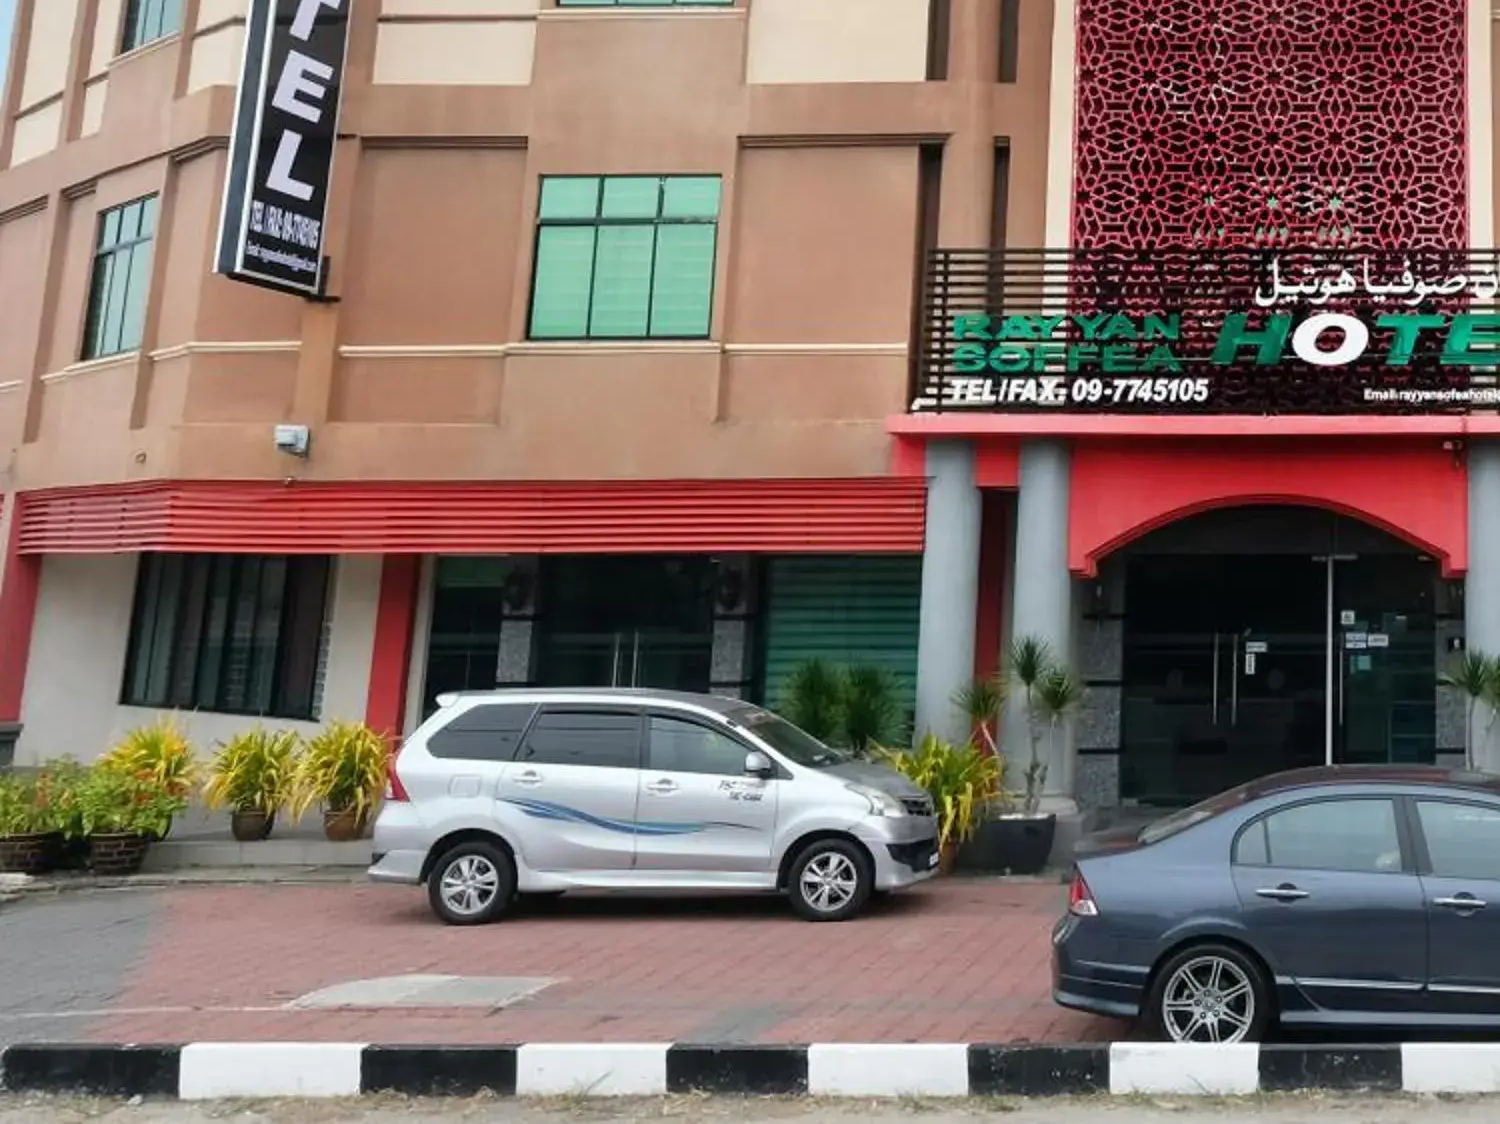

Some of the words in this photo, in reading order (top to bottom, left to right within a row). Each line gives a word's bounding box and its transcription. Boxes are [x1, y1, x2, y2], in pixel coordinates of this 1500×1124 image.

[952, 313, 1181, 341] RAYYAN
[951, 343, 1183, 373] SOFFEA
[1071, 378, 1210, 402] 09-7745105
